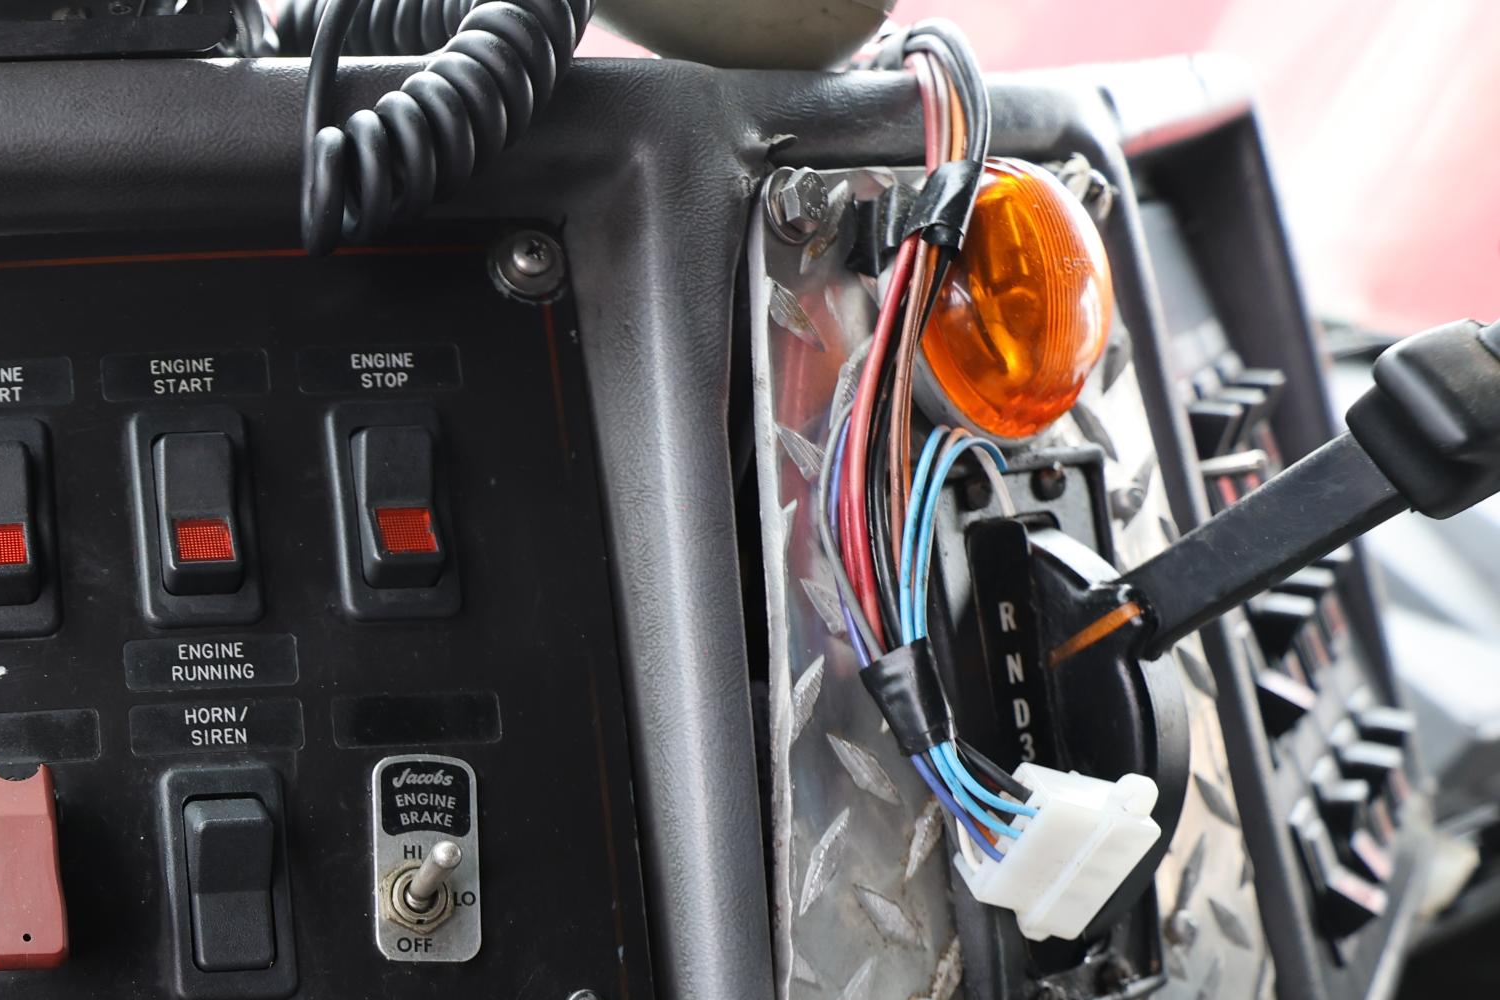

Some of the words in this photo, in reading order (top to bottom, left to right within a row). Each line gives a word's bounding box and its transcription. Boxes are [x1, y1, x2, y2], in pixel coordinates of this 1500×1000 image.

[149, 357, 215, 375] ENGINE
[350, 352, 415, 369] ENGINE
[153, 377, 214, 395] START
[360, 372, 409, 389] STOP
[999, 601, 1016, 632] R
[177, 642, 245, 661] ENGINE
[171, 663, 255, 682] RUNNING
[1006, 653, 1024, 684] N
[184, 706, 249, 725] HORN/
[1013, 698, 1031, 729] D
[190, 729, 248, 747] SIREN
[1019, 732, 1035, 762] 3
[392, 768, 454, 788] Jacobs
[395, 792, 457, 810] ENGINE
[400, 811, 454, 828] BRAKE
[403, 845, 423, 860] HI
[453, 891, 476, 907] LO
[396, 937, 433, 953] OFF
